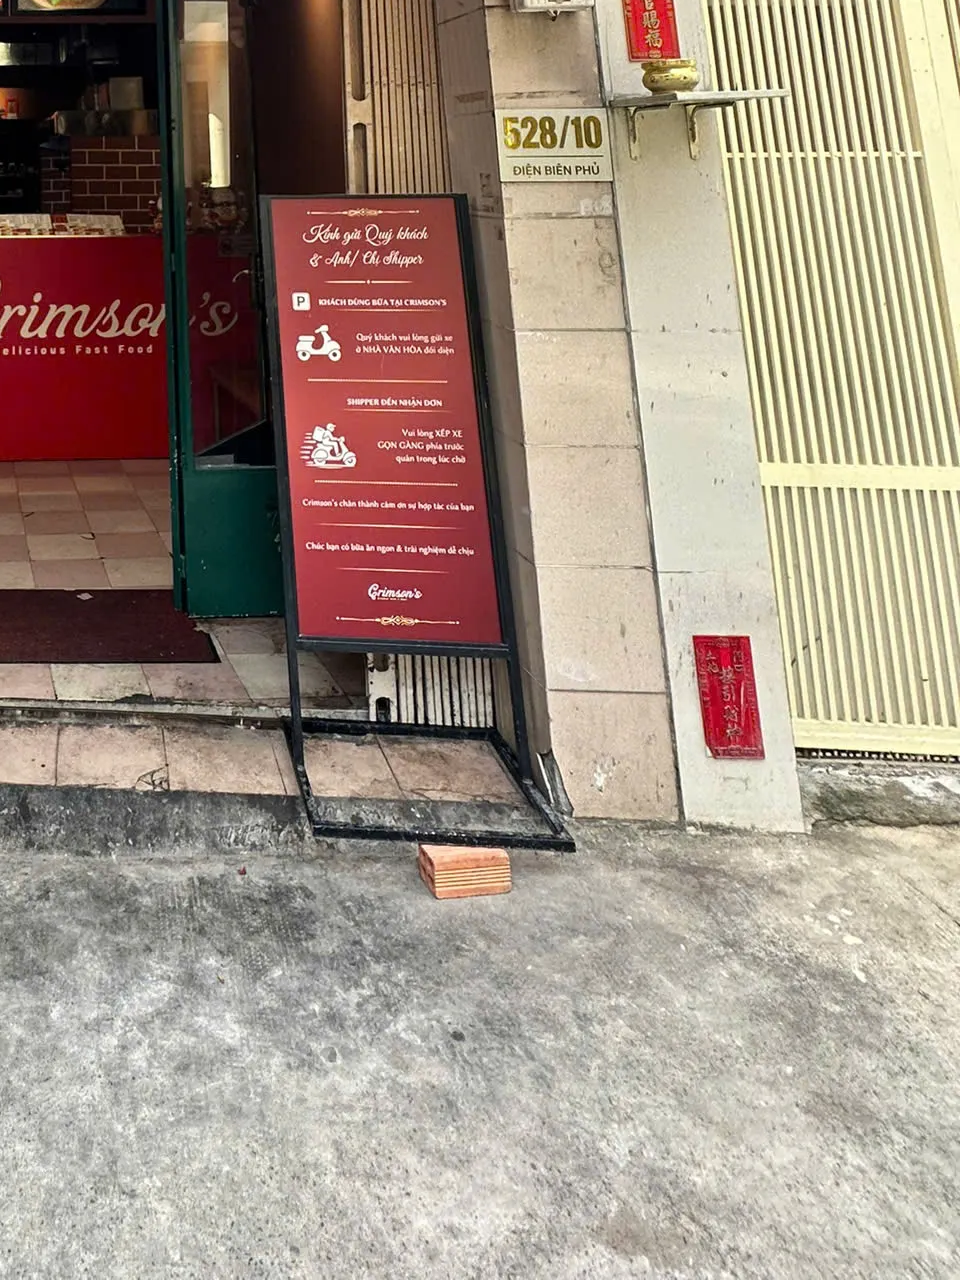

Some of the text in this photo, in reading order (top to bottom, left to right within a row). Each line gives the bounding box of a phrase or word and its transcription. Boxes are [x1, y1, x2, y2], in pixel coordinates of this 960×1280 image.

[502, 115, 603, 150] 528/10
[513, 161, 600, 179] ĐIỆN BIÊN PHỦ
[302, 223, 341, 244] Kính
[364, 223, 394, 247] Quý
[396, 226, 429, 240] khách
[309, 253, 323, 268] &
[362, 250, 381, 267] Chị
[382, 250, 425, 268] Shipper
[318, 297, 345, 306] KHÁCH
[390, 298, 403, 308] TẠI
[404, 298, 447, 307] CRIMSON'S
[356, 332, 373, 343] Quý
[374, 333, 397, 342] khách
[398, 334, 411, 342] vui
[75, 344, 109, 355] Fast
[118, 344, 154, 355] Food
[362, 345, 381, 354] NHÀ
[346, 398, 380, 407] SHIPPER
[401, 428, 416, 437] Vui
[417, 429, 434, 439] lòng
[452, 429, 463, 438] XE
[377, 441, 397, 450] GỌN
[399, 440, 424, 450] GÀNG
[416, 455, 437, 465] trong
[302, 498, 338, 507] Crimson's
[357, 500, 379, 508] thành
[460, 503, 475, 512] bạn
[305, 541, 325, 551] Chúc
[326, 542, 340, 552] bạn
[340, 542, 350, 551] có
[376, 545, 395, 554] ngon
[396, 544, 403, 552] &
[418, 544, 446, 556] nghiệm
[367, 583, 423, 600] Crimson's
